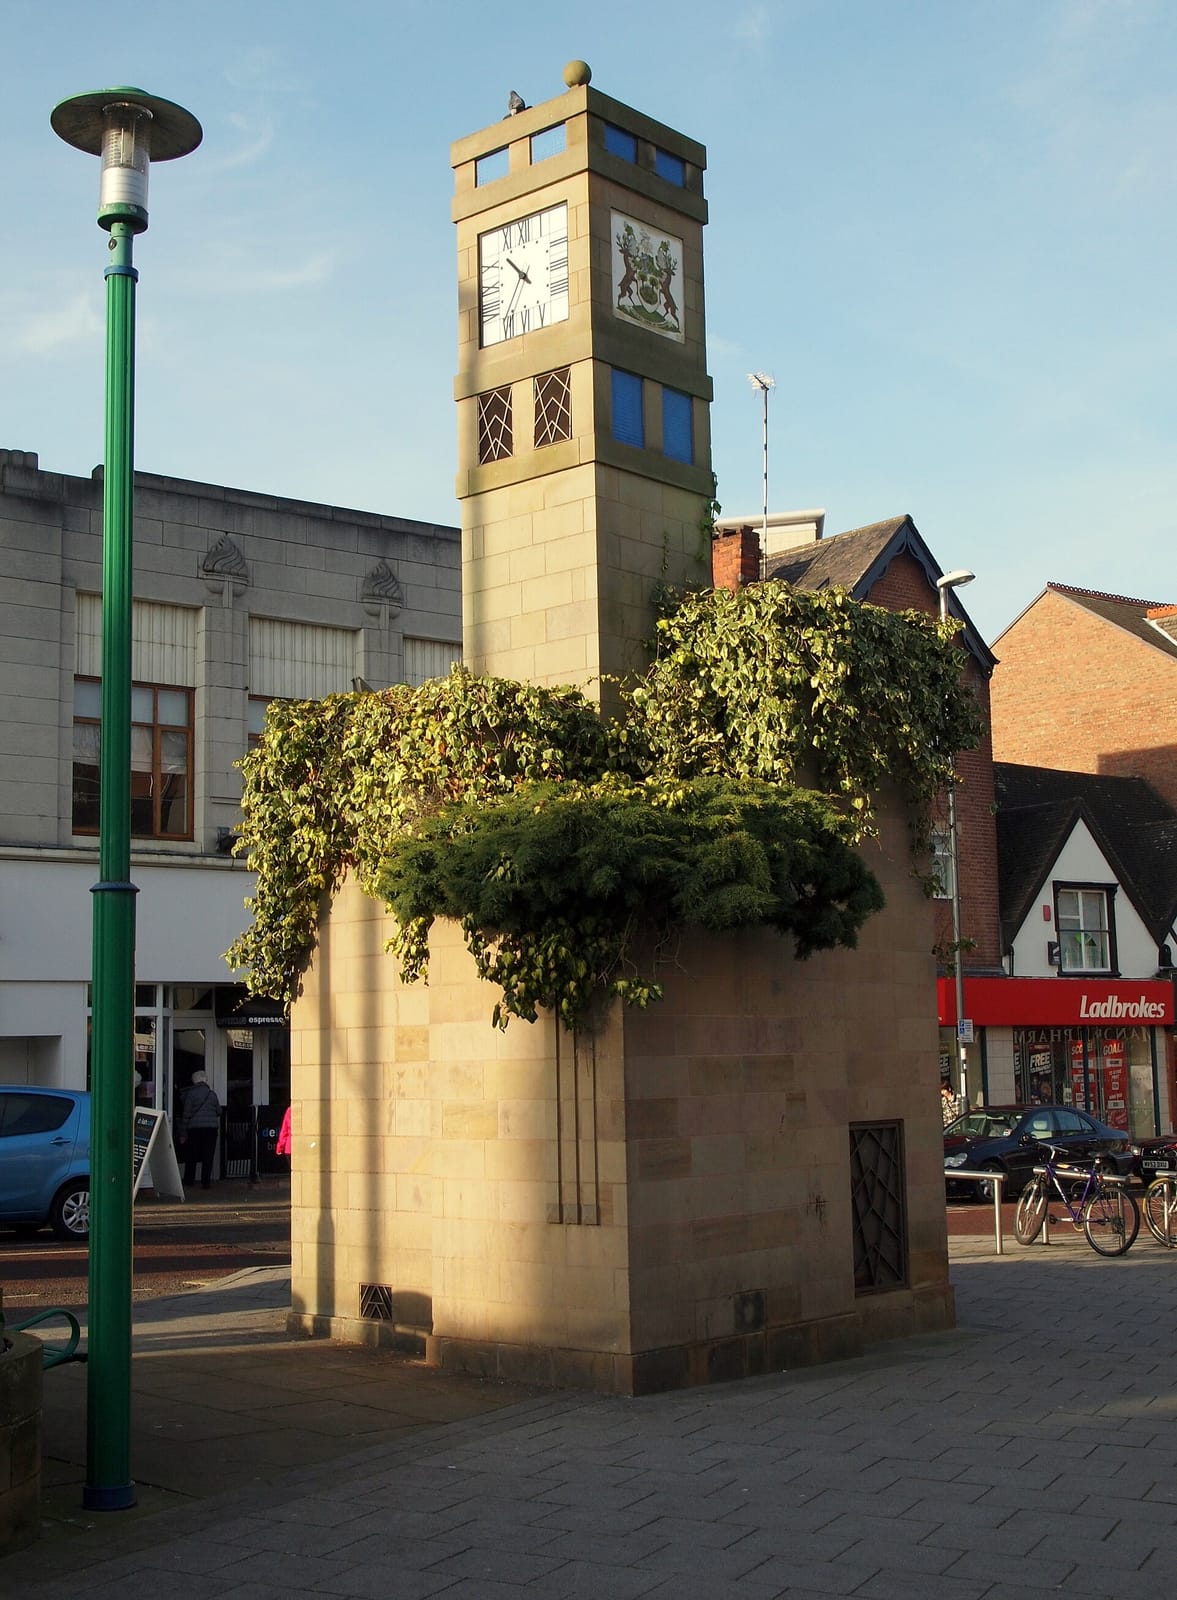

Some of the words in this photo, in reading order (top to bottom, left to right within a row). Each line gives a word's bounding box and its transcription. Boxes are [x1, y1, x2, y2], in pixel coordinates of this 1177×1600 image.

[502, 226, 511, 252] XI
[517, 219, 530, 246] XII
[549, 236, 568, 248] II
[549, 257, 568, 272] III
[520, 309, 530, 334] VI
[538, 303, 546, 329] V
[1079, 995, 1166, 1018] Ladbrokes
[1030, 1052, 1051, 1068] FREE
